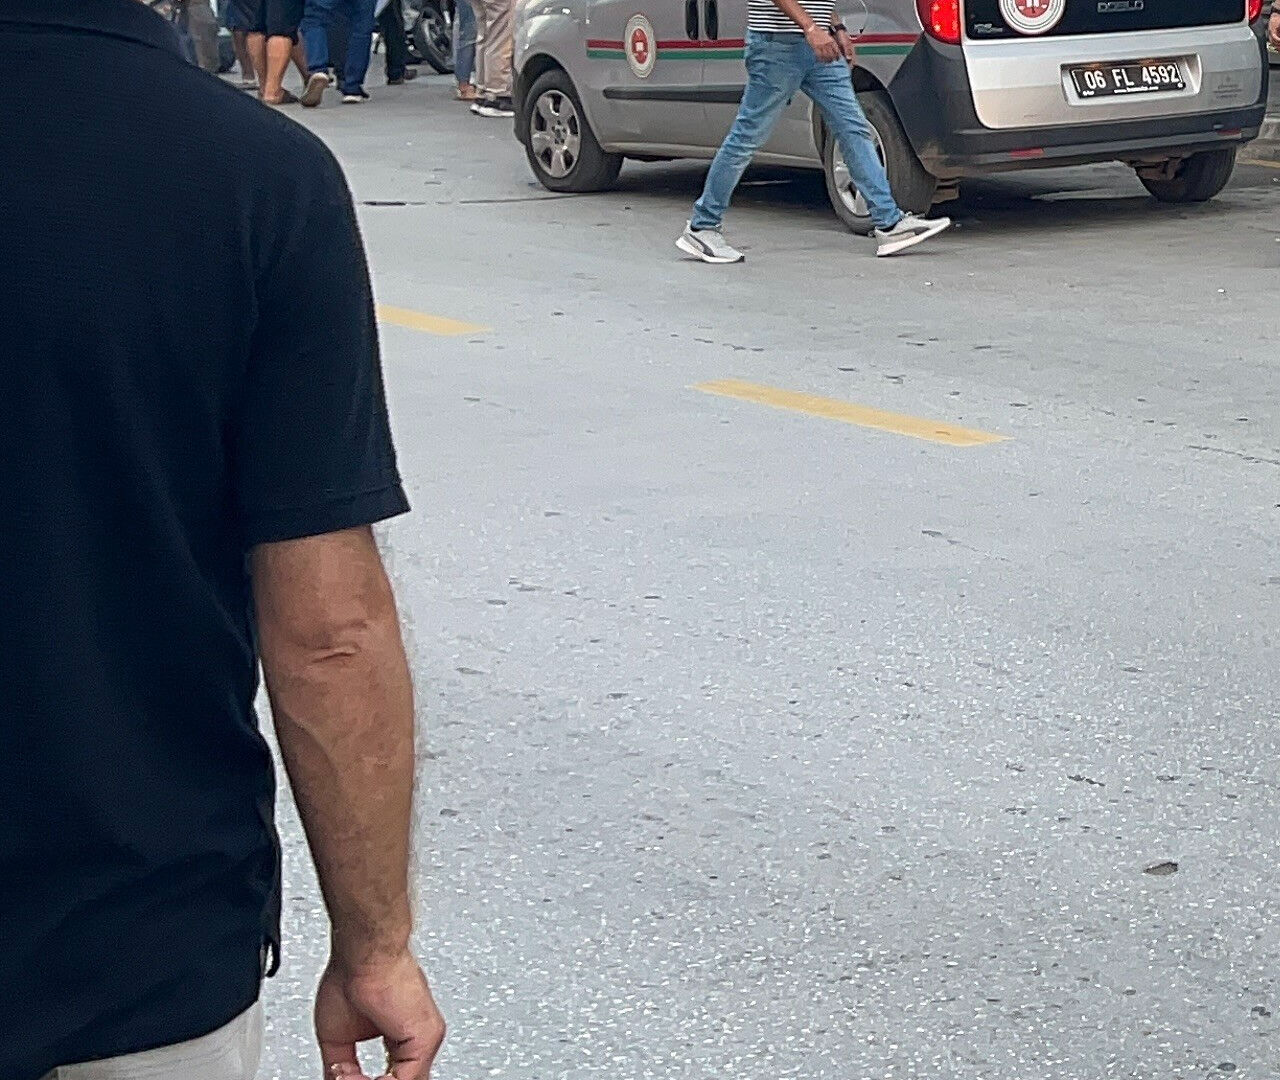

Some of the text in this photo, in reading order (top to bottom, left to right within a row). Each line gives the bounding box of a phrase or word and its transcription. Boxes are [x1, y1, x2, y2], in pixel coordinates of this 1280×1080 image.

[1084, 65, 1180, 89] 06 FL 4592
